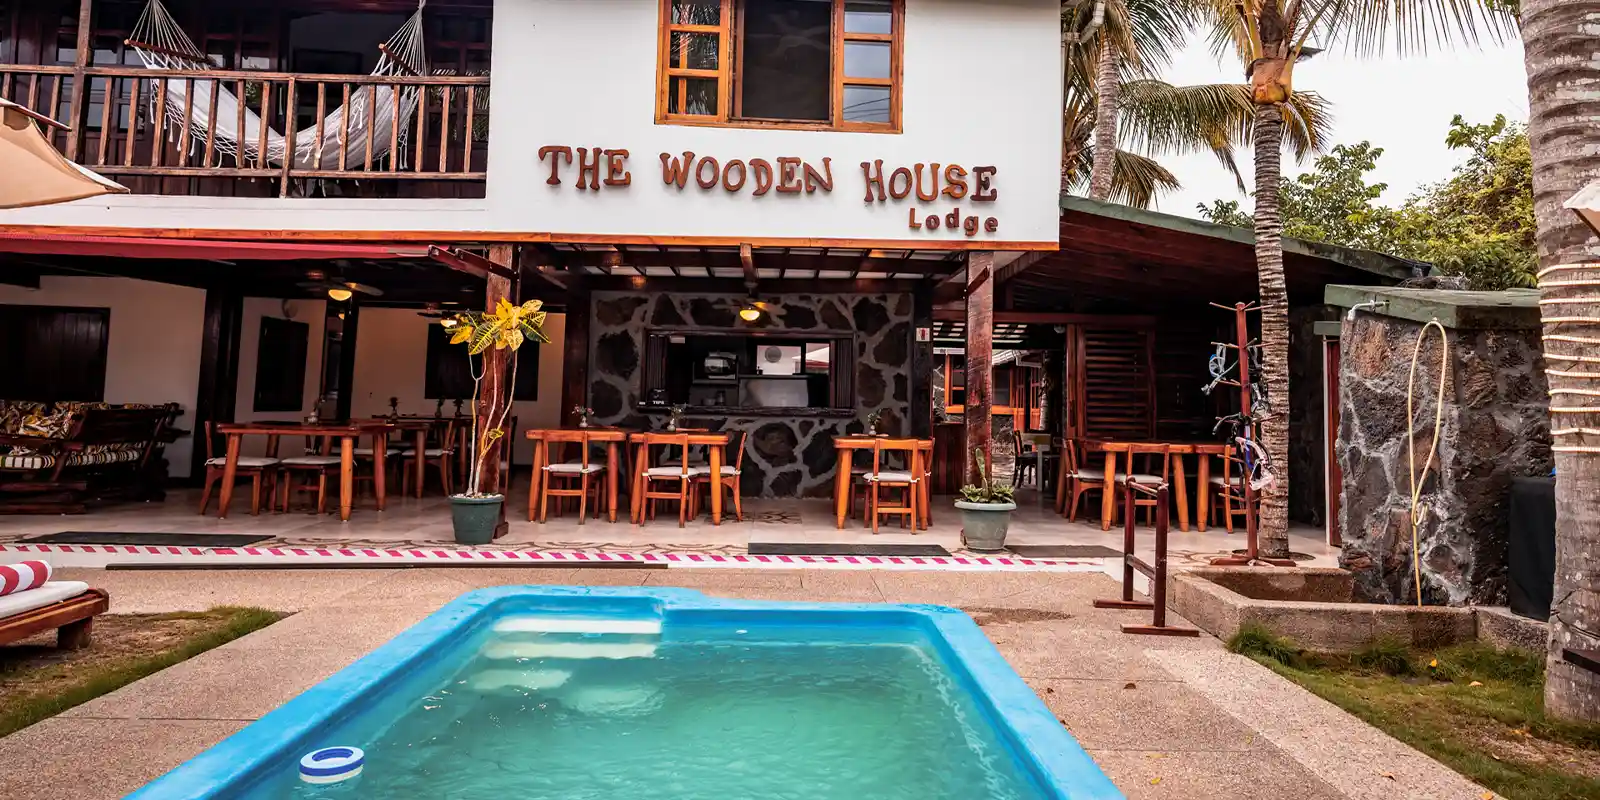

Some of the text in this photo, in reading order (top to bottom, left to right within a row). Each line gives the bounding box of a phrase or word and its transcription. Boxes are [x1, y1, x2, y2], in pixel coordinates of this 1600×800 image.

[538, 145, 998, 203] THE WOODEN HOUSE
[908, 207, 999, 237] Lodge
